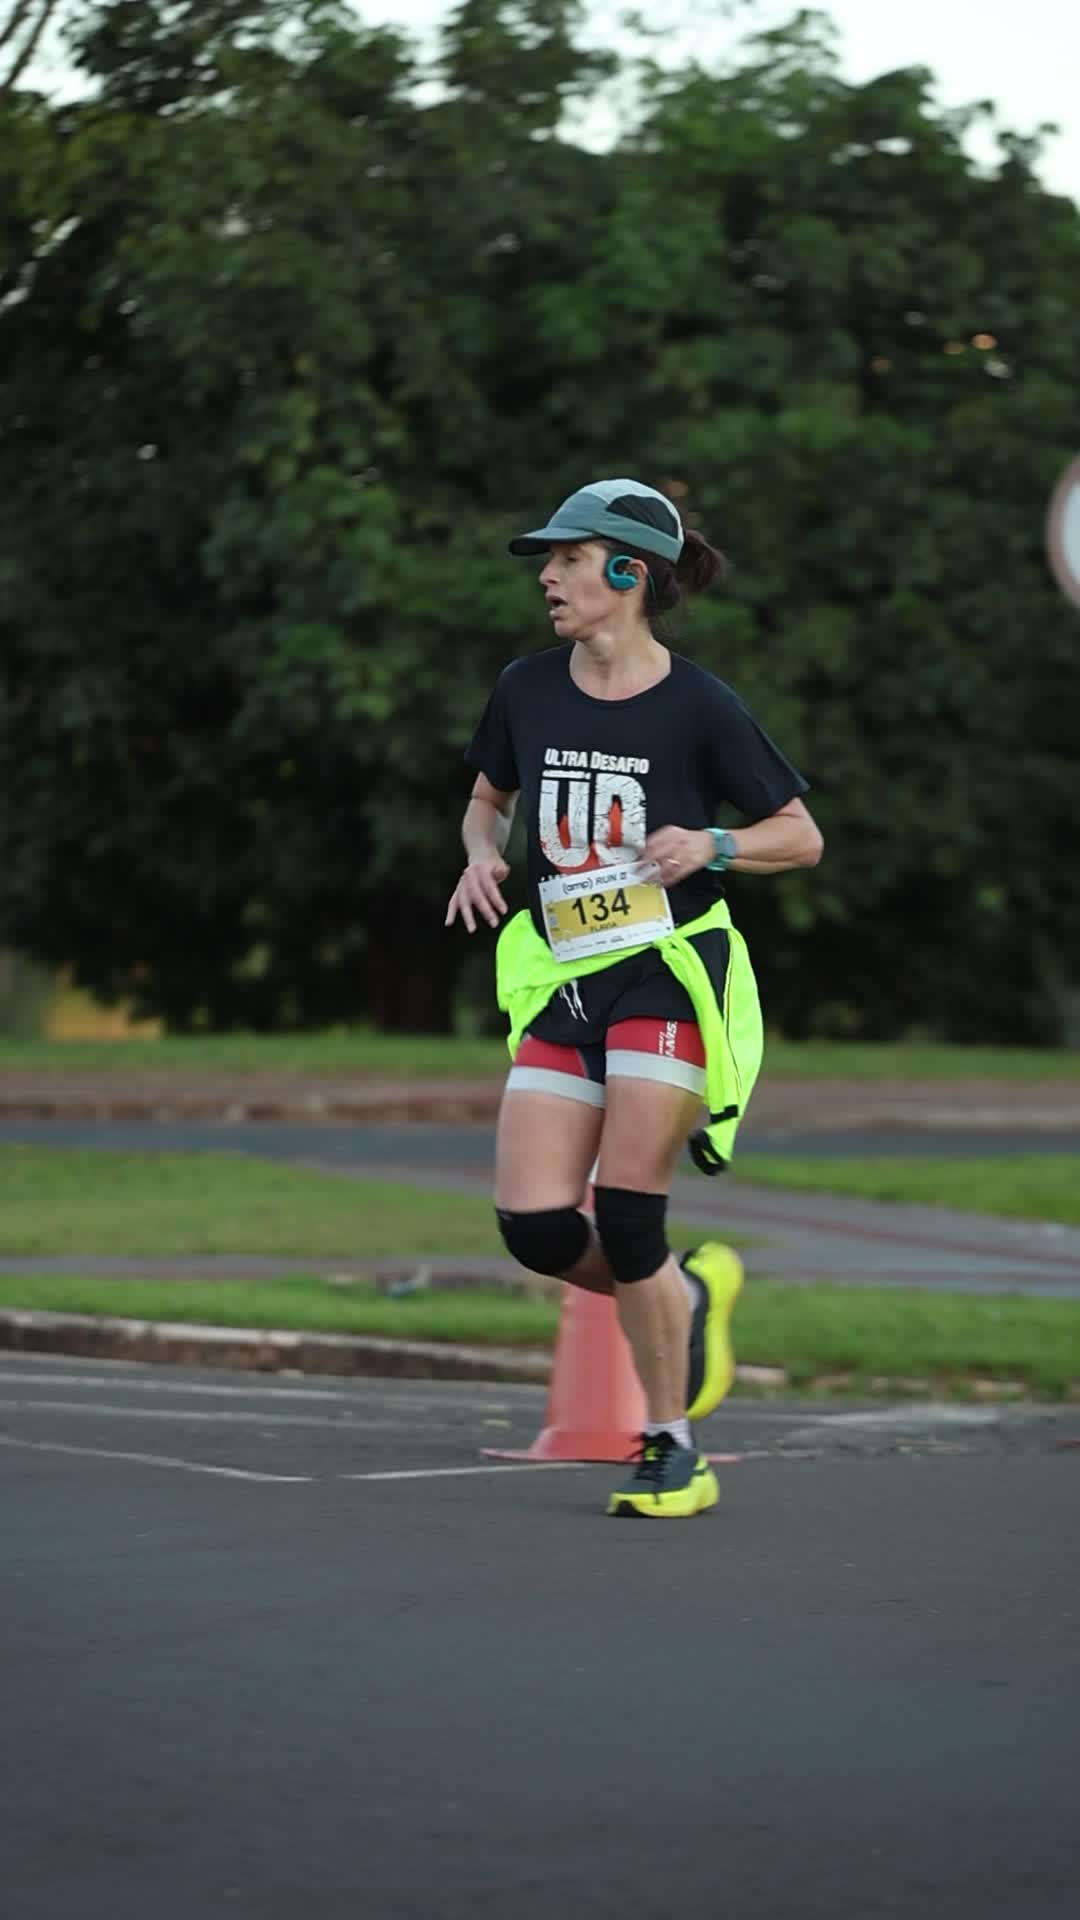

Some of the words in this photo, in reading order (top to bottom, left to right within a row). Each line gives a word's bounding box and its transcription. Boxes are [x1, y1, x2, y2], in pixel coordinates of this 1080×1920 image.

[544, 748, 588, 768] ULTRA
[590, 751, 650, 774] DESAFIO
[594, 874, 617, 886] RUN
[571, 887, 631, 925] 134
